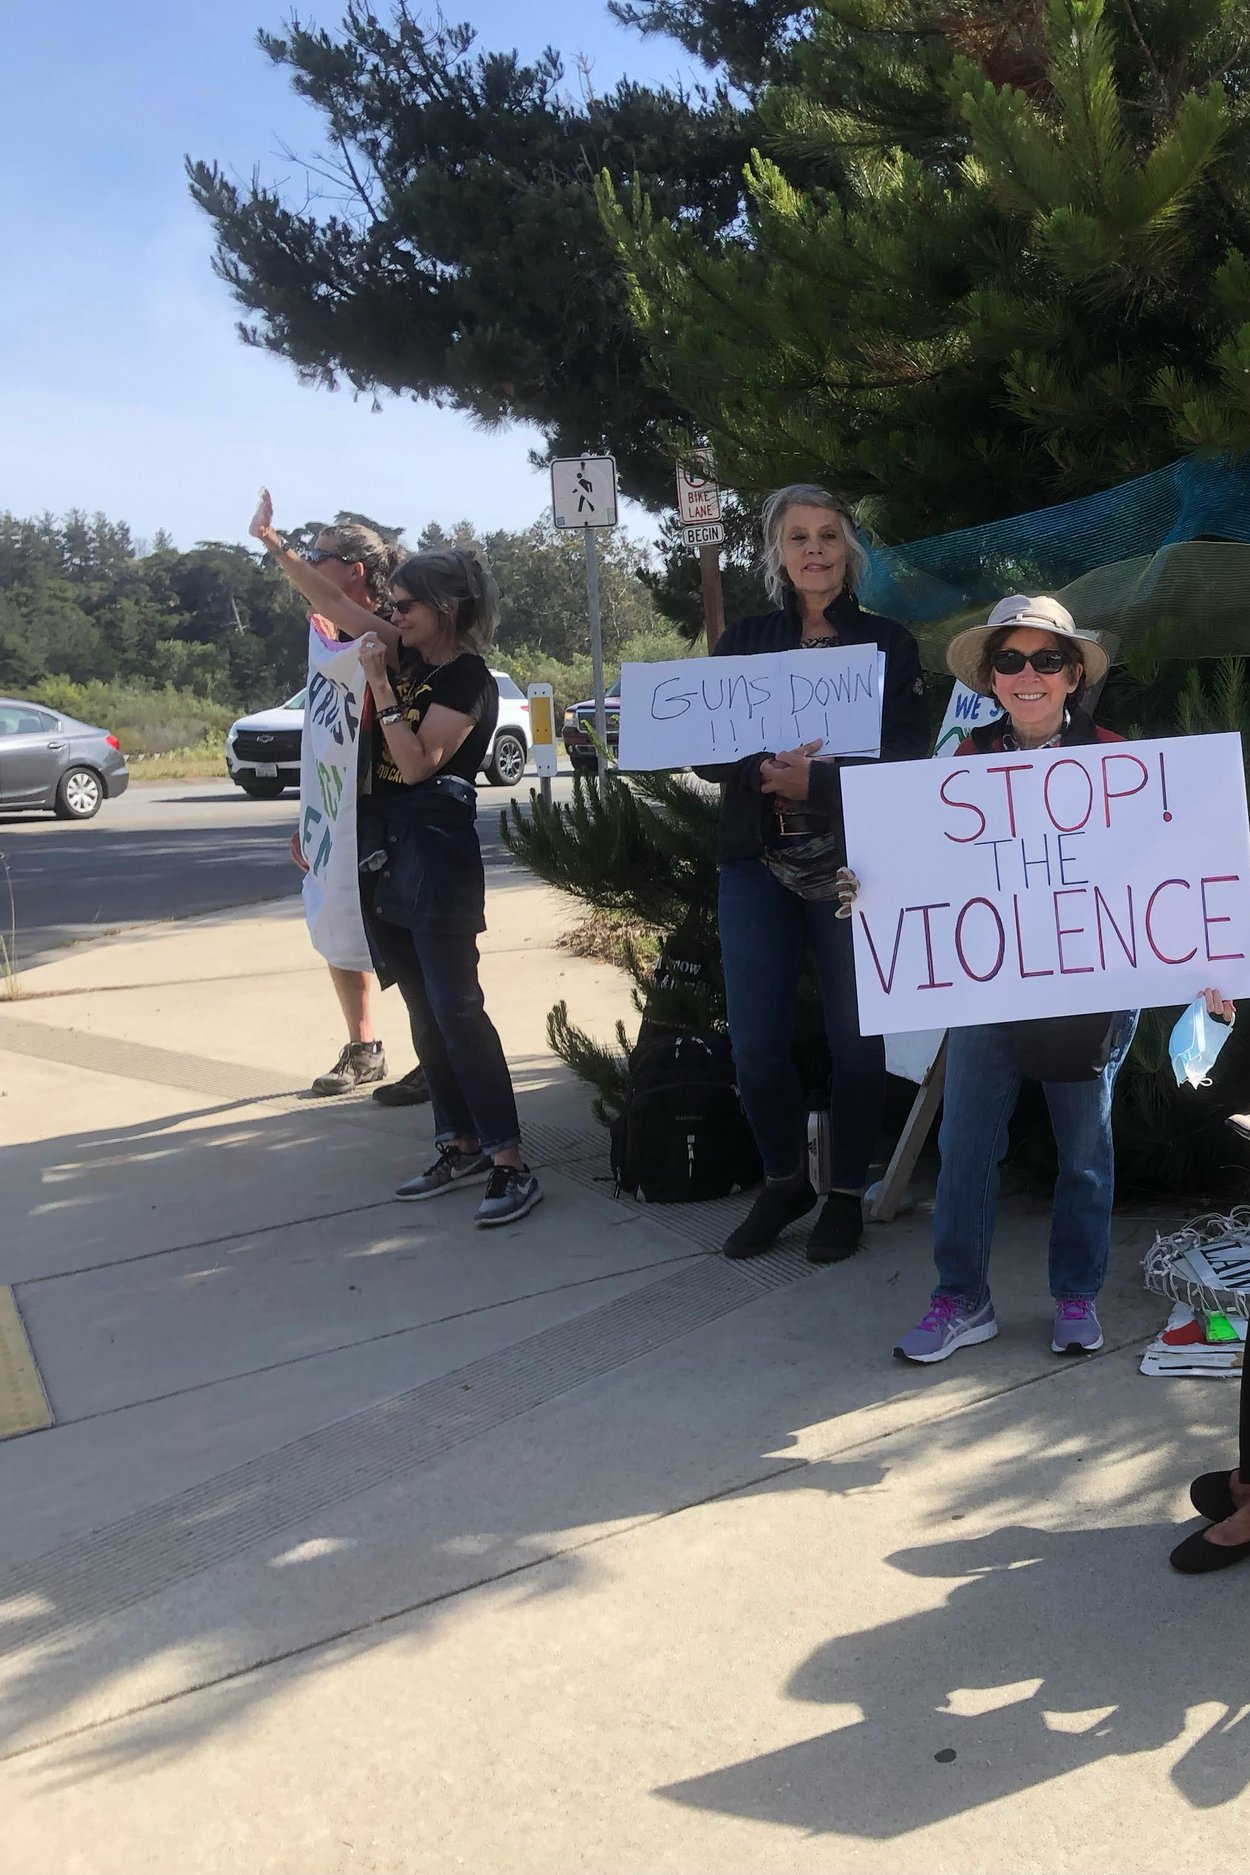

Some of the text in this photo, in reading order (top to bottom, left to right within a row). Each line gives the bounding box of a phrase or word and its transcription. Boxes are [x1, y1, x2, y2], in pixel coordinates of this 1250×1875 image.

[687, 491, 710, 504] BIKE
[688, 506, 713, 518] LANE
[687, 527, 719, 543] BEGIN
[790, 664, 873, 715] DOWN
[955, 693, 982, 720] WE
[939, 752, 1174, 843] STOP!
[973, 831, 1090, 892] THE
[858, 875, 1246, 995] VIOLENCE
